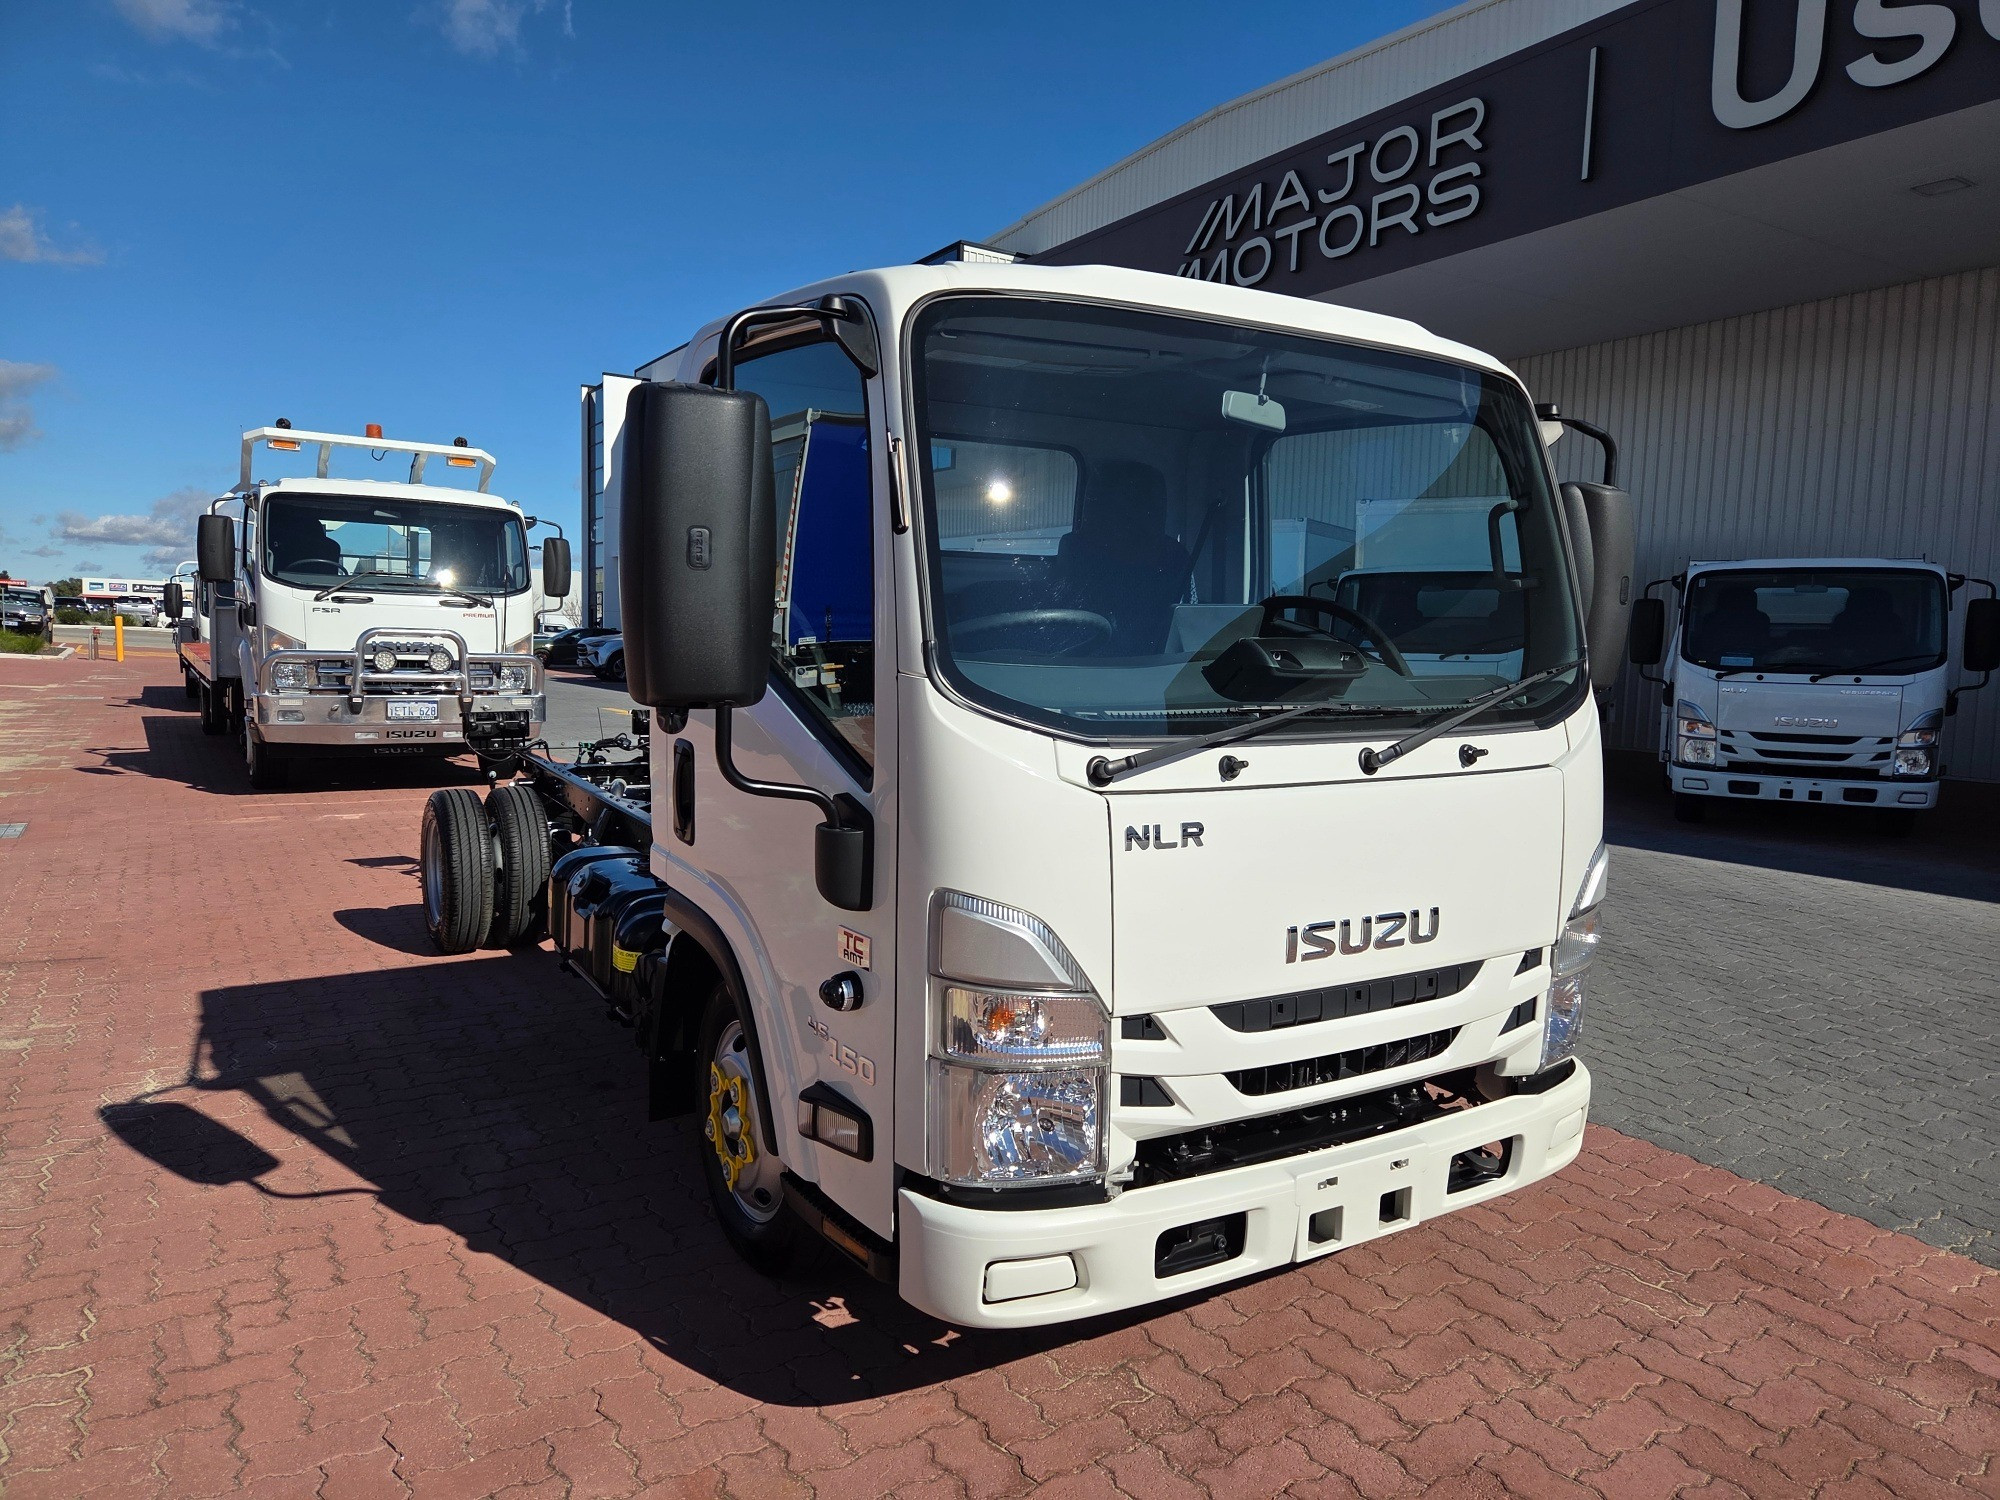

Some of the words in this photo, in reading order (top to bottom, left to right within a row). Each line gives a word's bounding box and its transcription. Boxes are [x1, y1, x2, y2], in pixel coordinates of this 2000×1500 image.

[1184, 97, 1485, 255] MAJOR
[419, 706, 436, 716] 628
[1774, 716, 1838, 728] ISUZU
[386, 730, 436, 738] ISUZU
[1124, 821, 1205, 852] NLR
[843, 930, 864, 955] TC
[1285, 906, 1440, 964] ISUZU
[843, 948, 864, 966] AMT
[829, 1036, 876, 1086] 150
